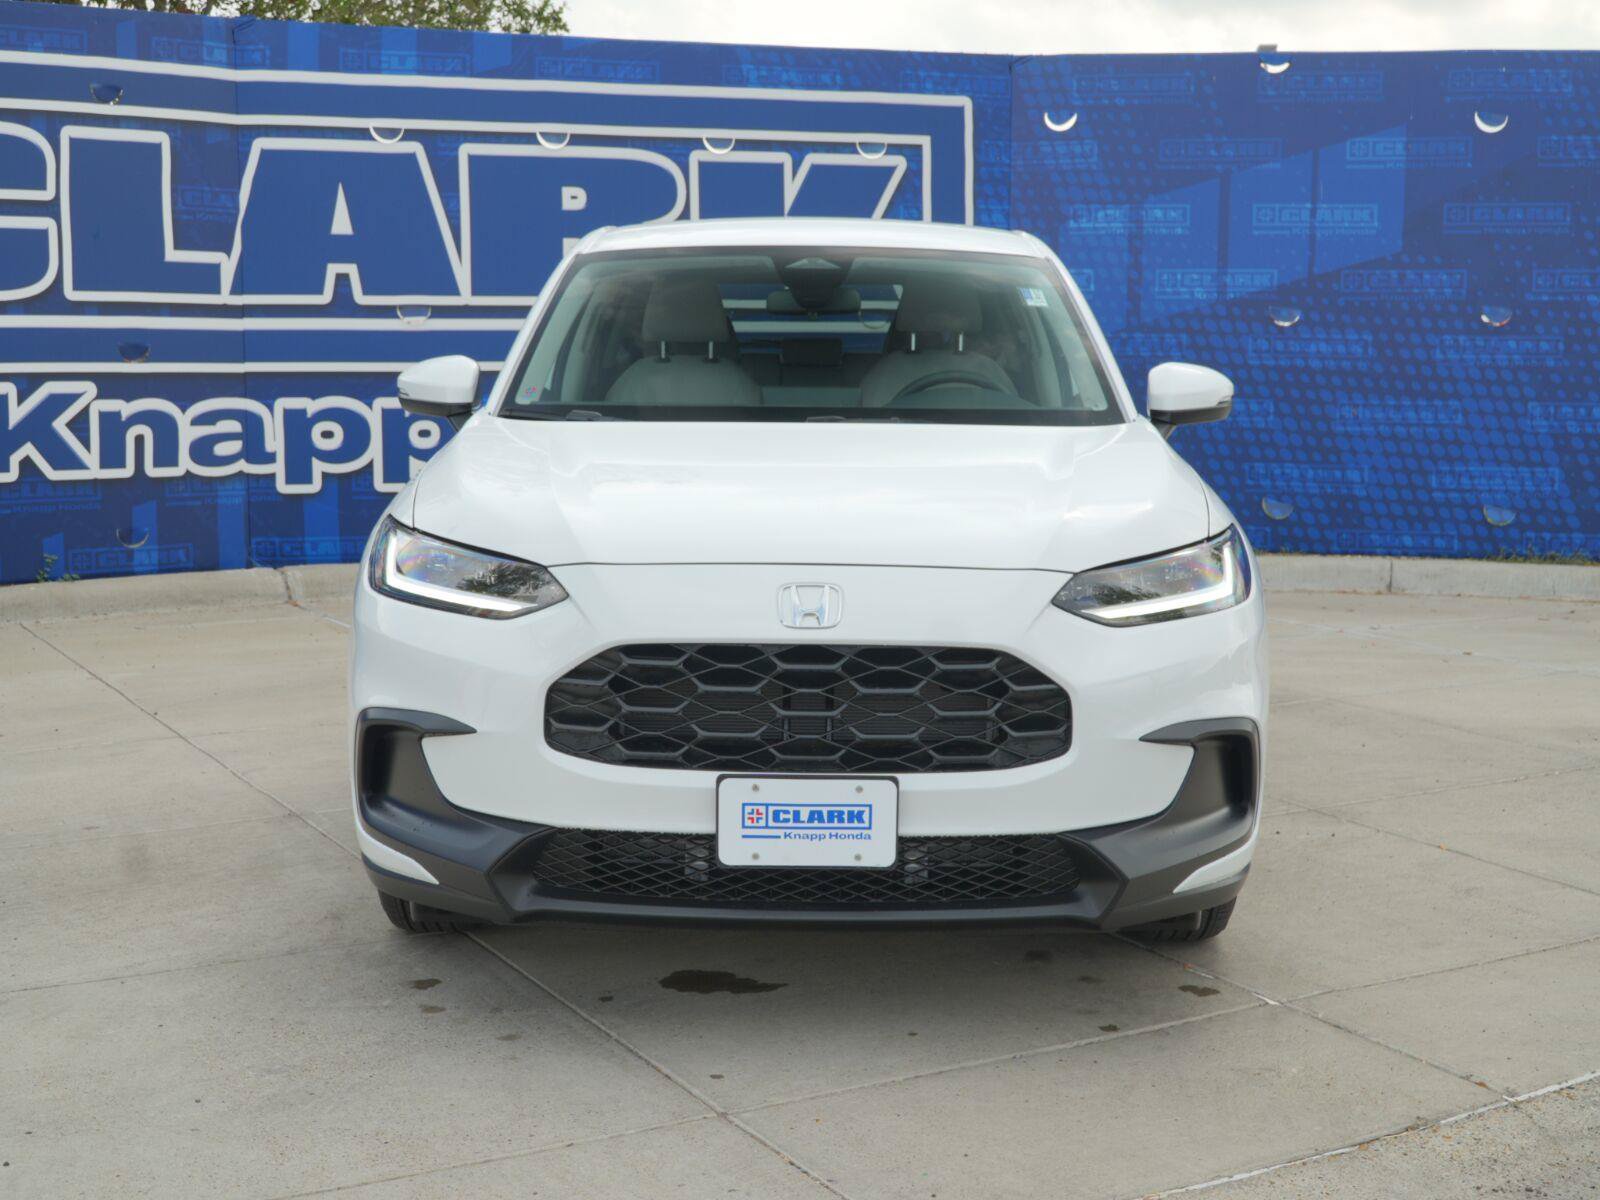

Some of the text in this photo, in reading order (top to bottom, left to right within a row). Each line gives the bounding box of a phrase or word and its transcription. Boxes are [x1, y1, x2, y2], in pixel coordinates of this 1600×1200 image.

[0, 381, 450, 494] Knapp
[772, 809, 866, 824] CLARK
[783, 831, 872, 842] Knapp Honda
